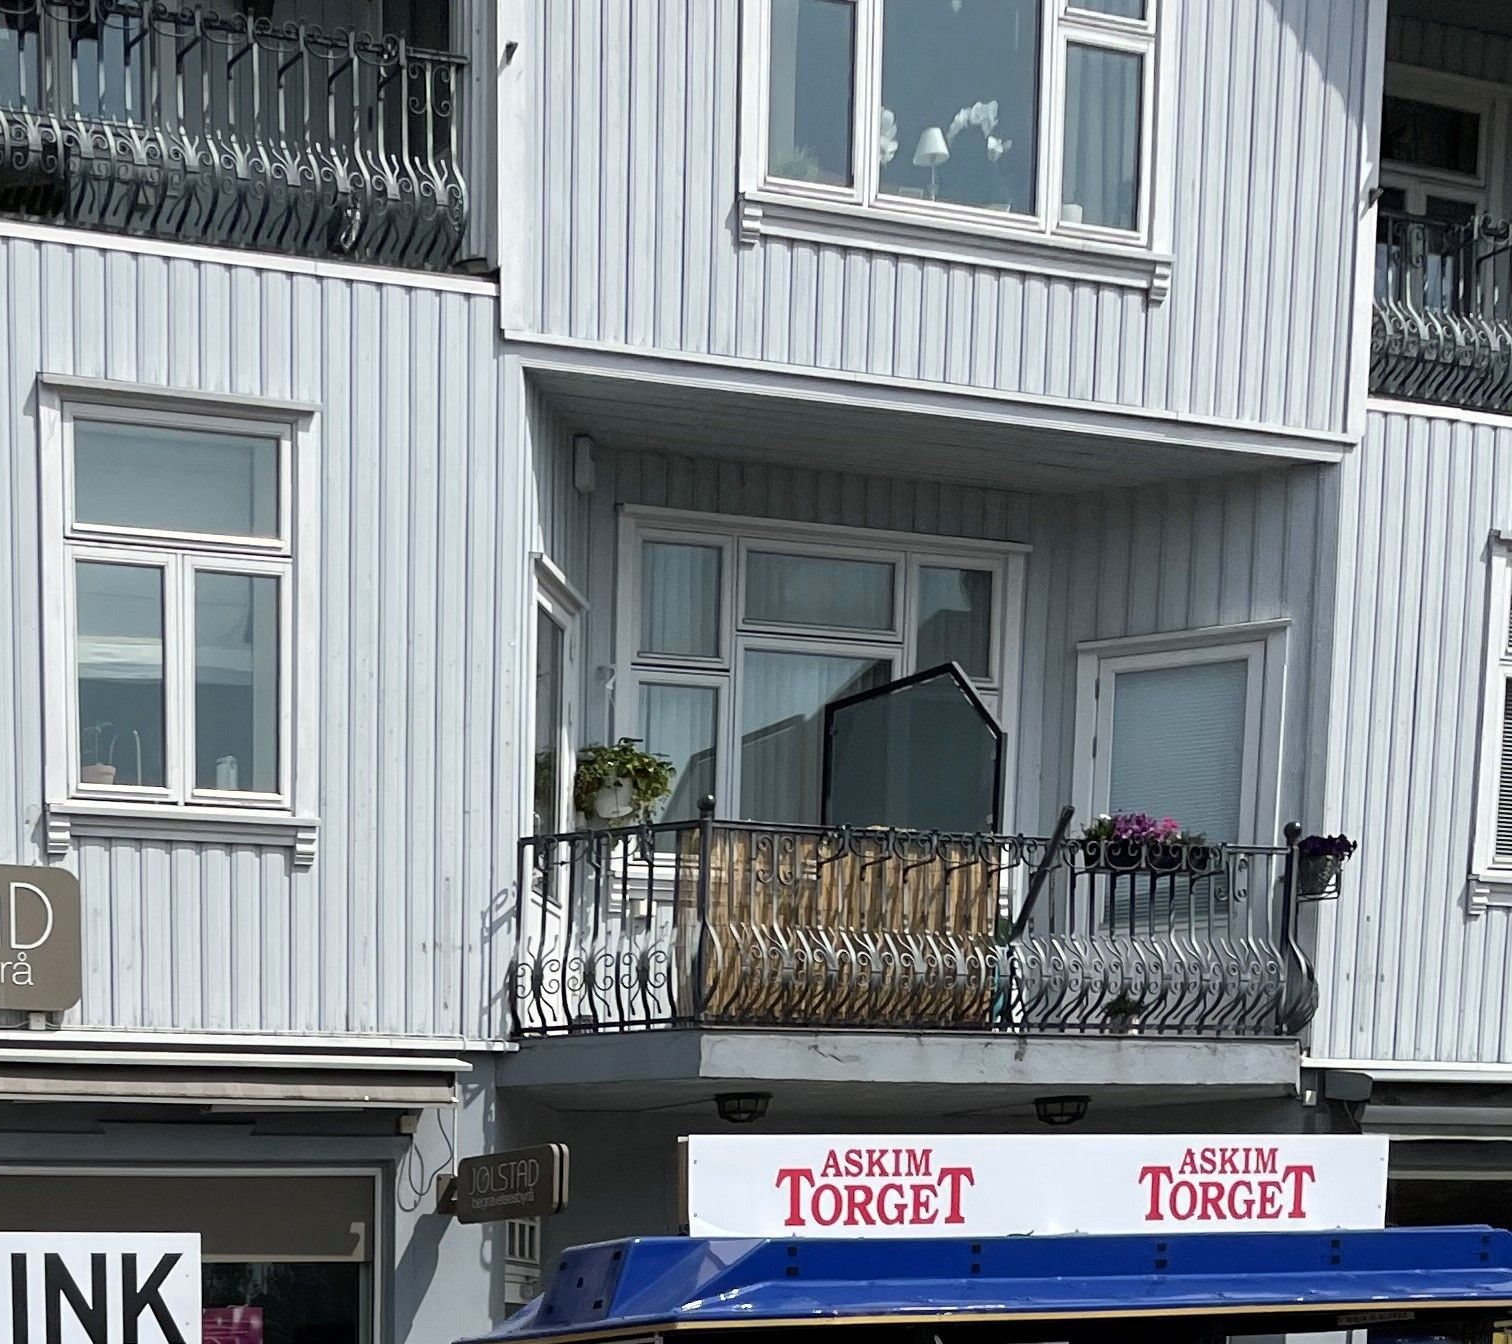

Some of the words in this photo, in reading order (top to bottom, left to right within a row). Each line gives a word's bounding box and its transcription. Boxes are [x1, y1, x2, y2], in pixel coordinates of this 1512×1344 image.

[468, 1158, 540, 1195] JØLSTAD
[820, 1148, 933, 1177] ASKIM
[1178, 1147, 1279, 1175] ASKIM
[775, 1167, 975, 1226] TORGET
[1138, 1165, 1316, 1221] TORGET
